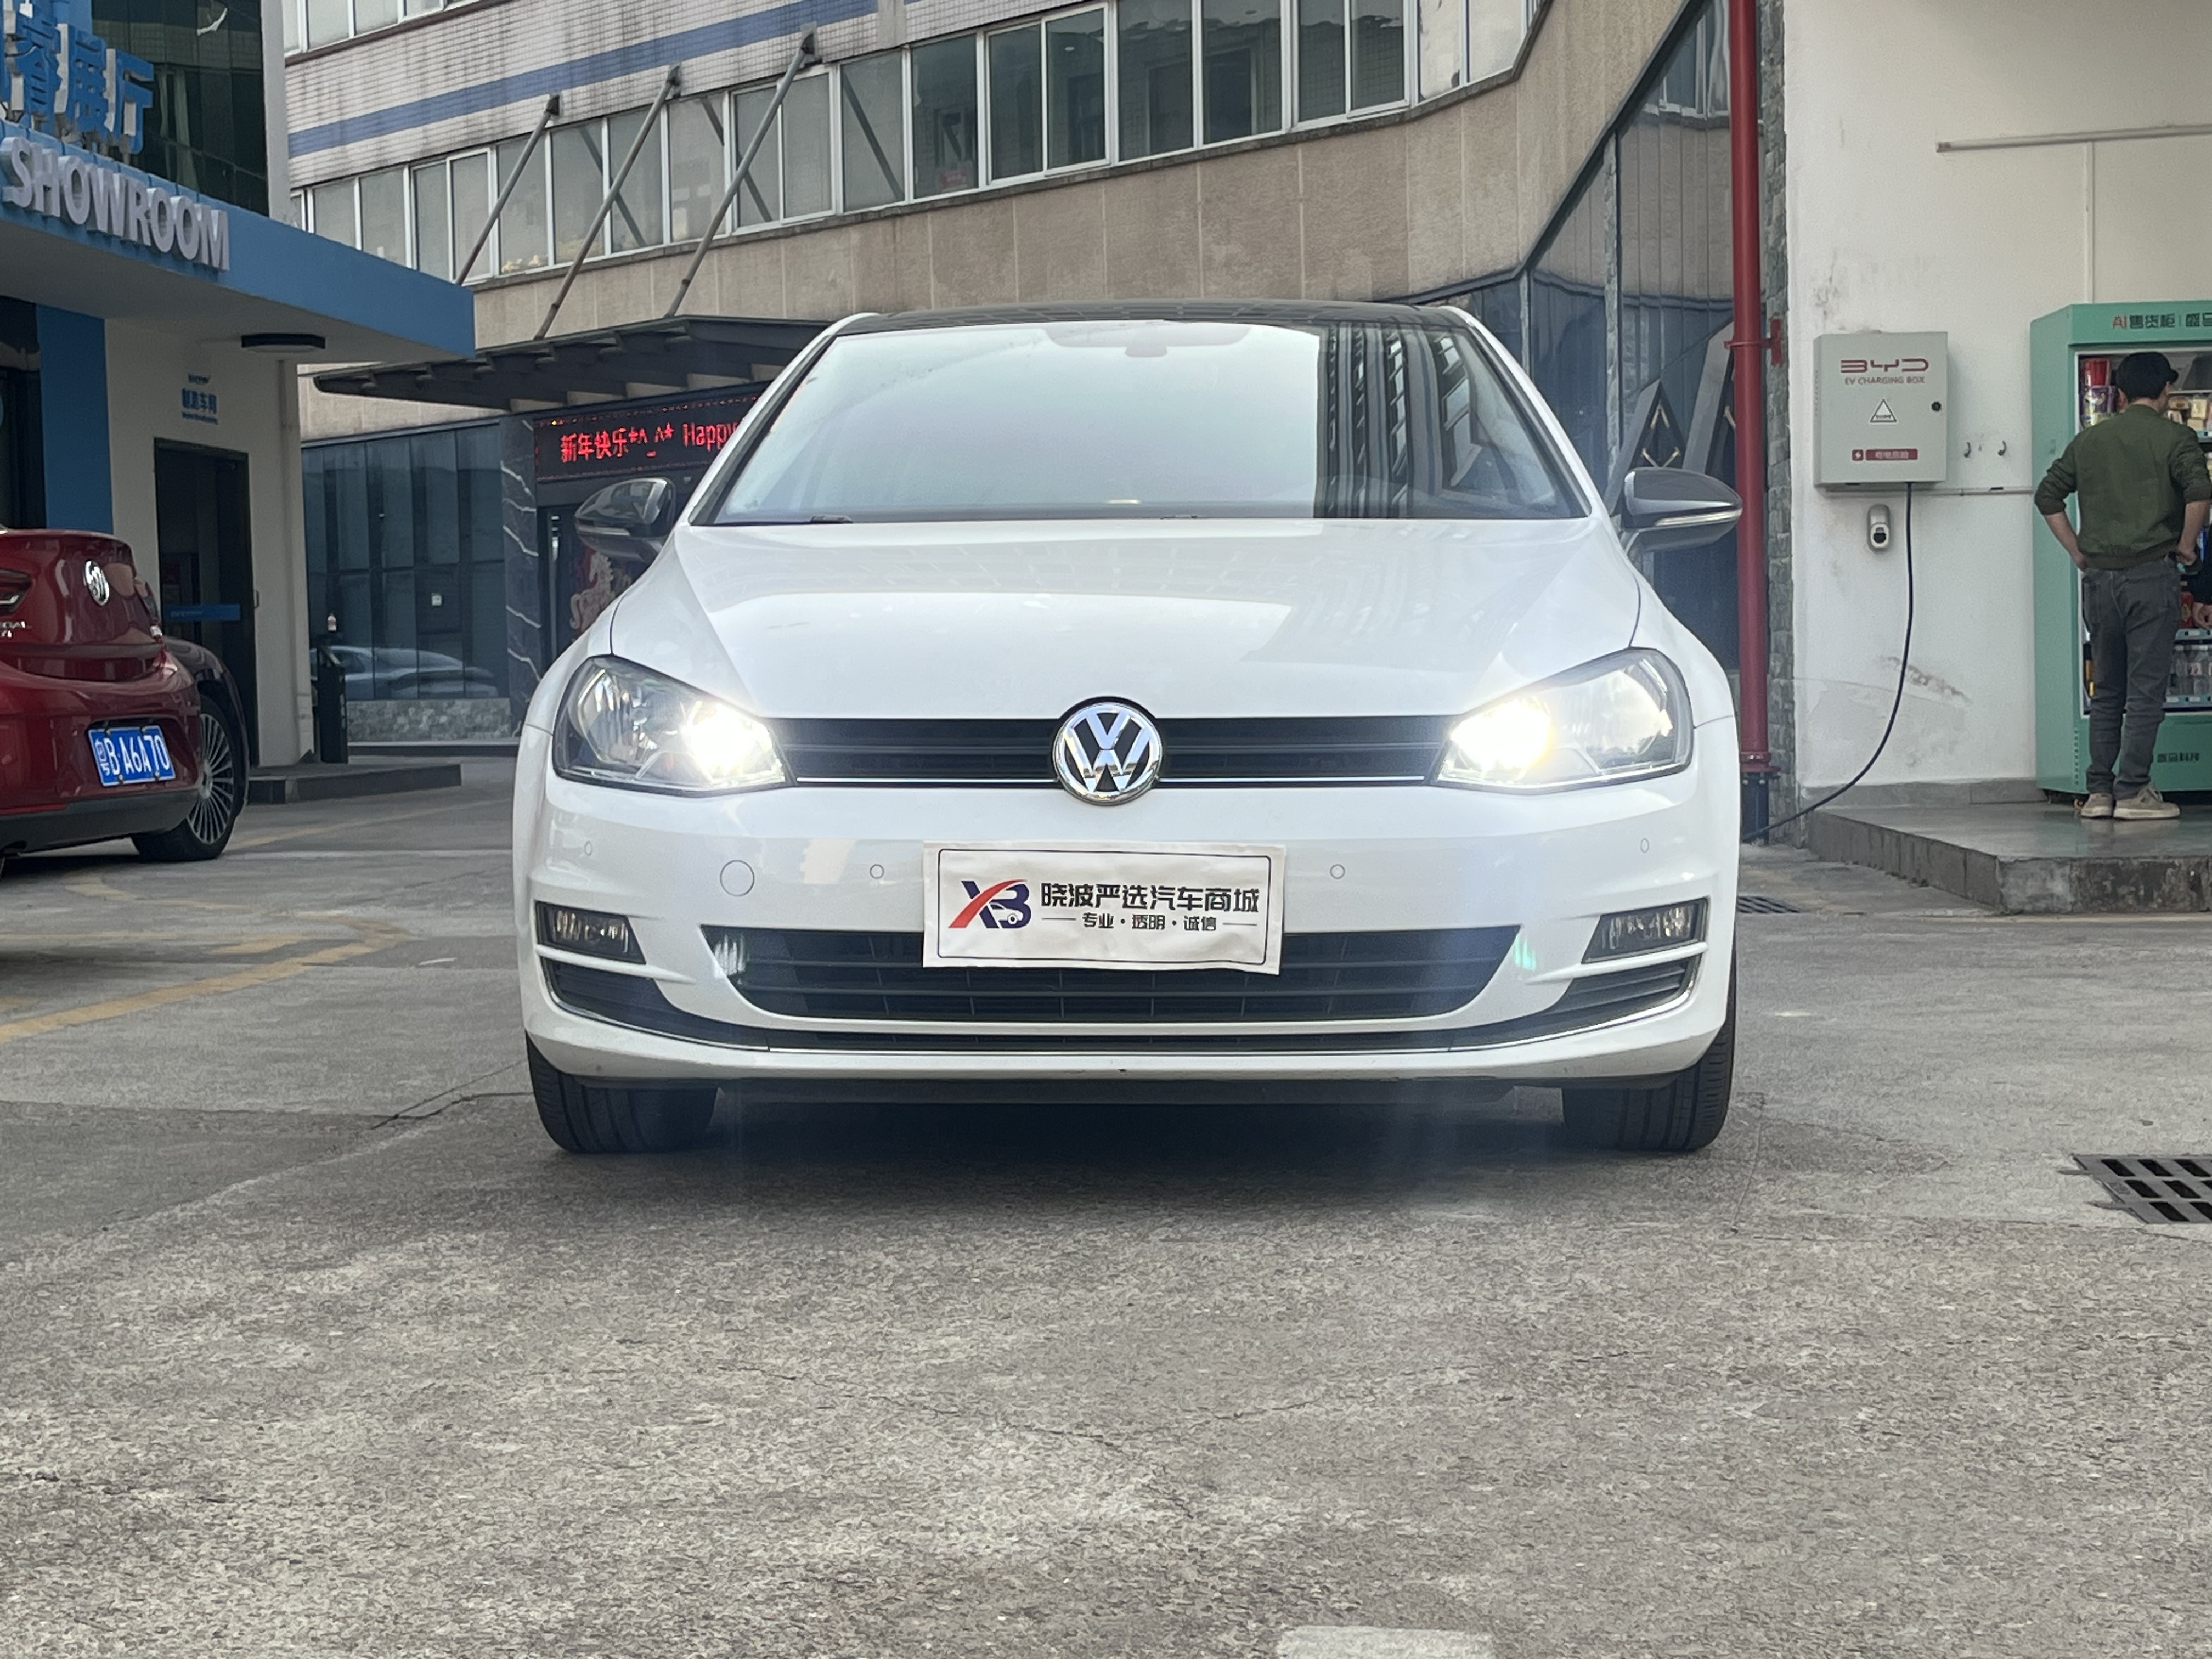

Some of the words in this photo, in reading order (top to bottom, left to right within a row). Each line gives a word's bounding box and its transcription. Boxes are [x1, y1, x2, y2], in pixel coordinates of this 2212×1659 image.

[1, 136, 230, 271] SHOWROOM
[1841, 358, 1929, 373] BYD
[1844, 377, 1855, 385] EV
[1858, 376, 1904, 385] CHARGING
[1906, 376, 1925, 384] BOX
[561, 427, 629, 462] 新年快乐
[1041, 883, 1260, 913] 晓波严选汽车商城
